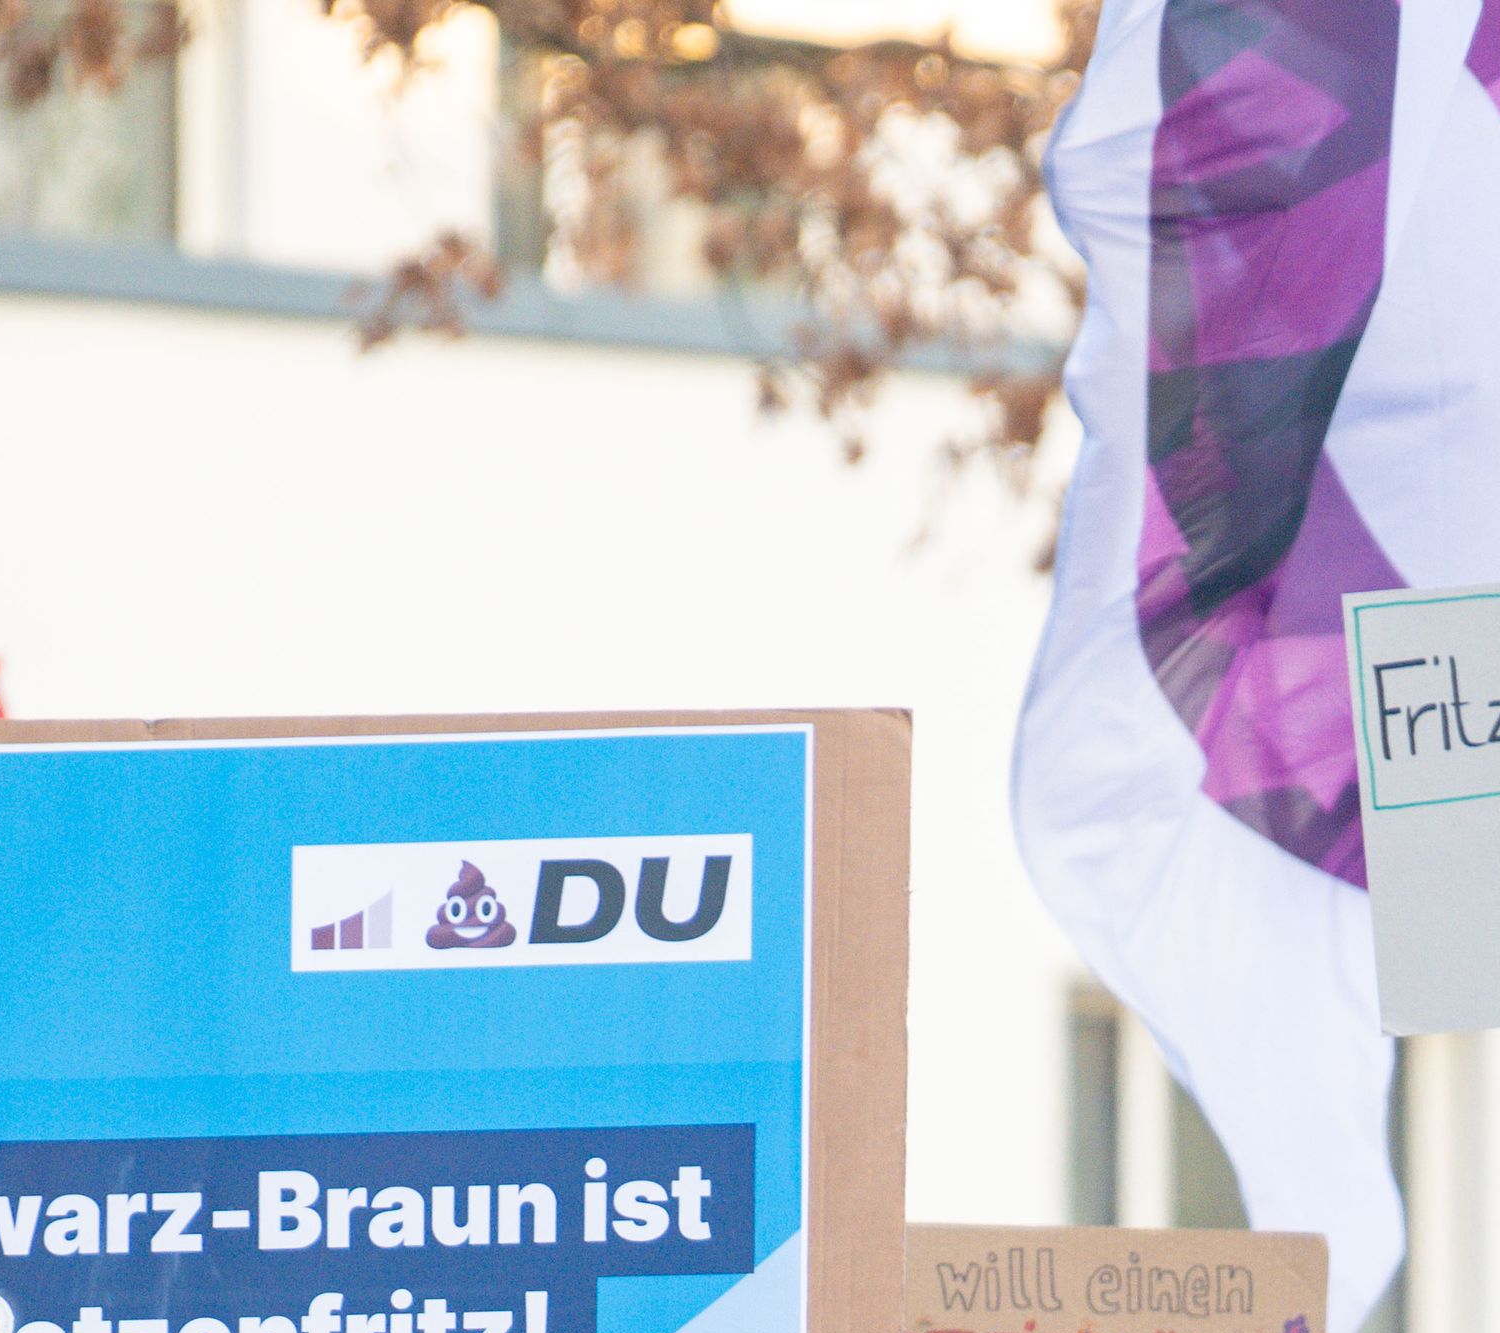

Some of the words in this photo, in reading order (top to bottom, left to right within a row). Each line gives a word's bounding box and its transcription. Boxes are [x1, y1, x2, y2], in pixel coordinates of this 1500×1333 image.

[583, 1157, 712, 1245] ist
[936, 1247, 1064, 1312] will
[1085, 1250, 1255, 1318] einen
